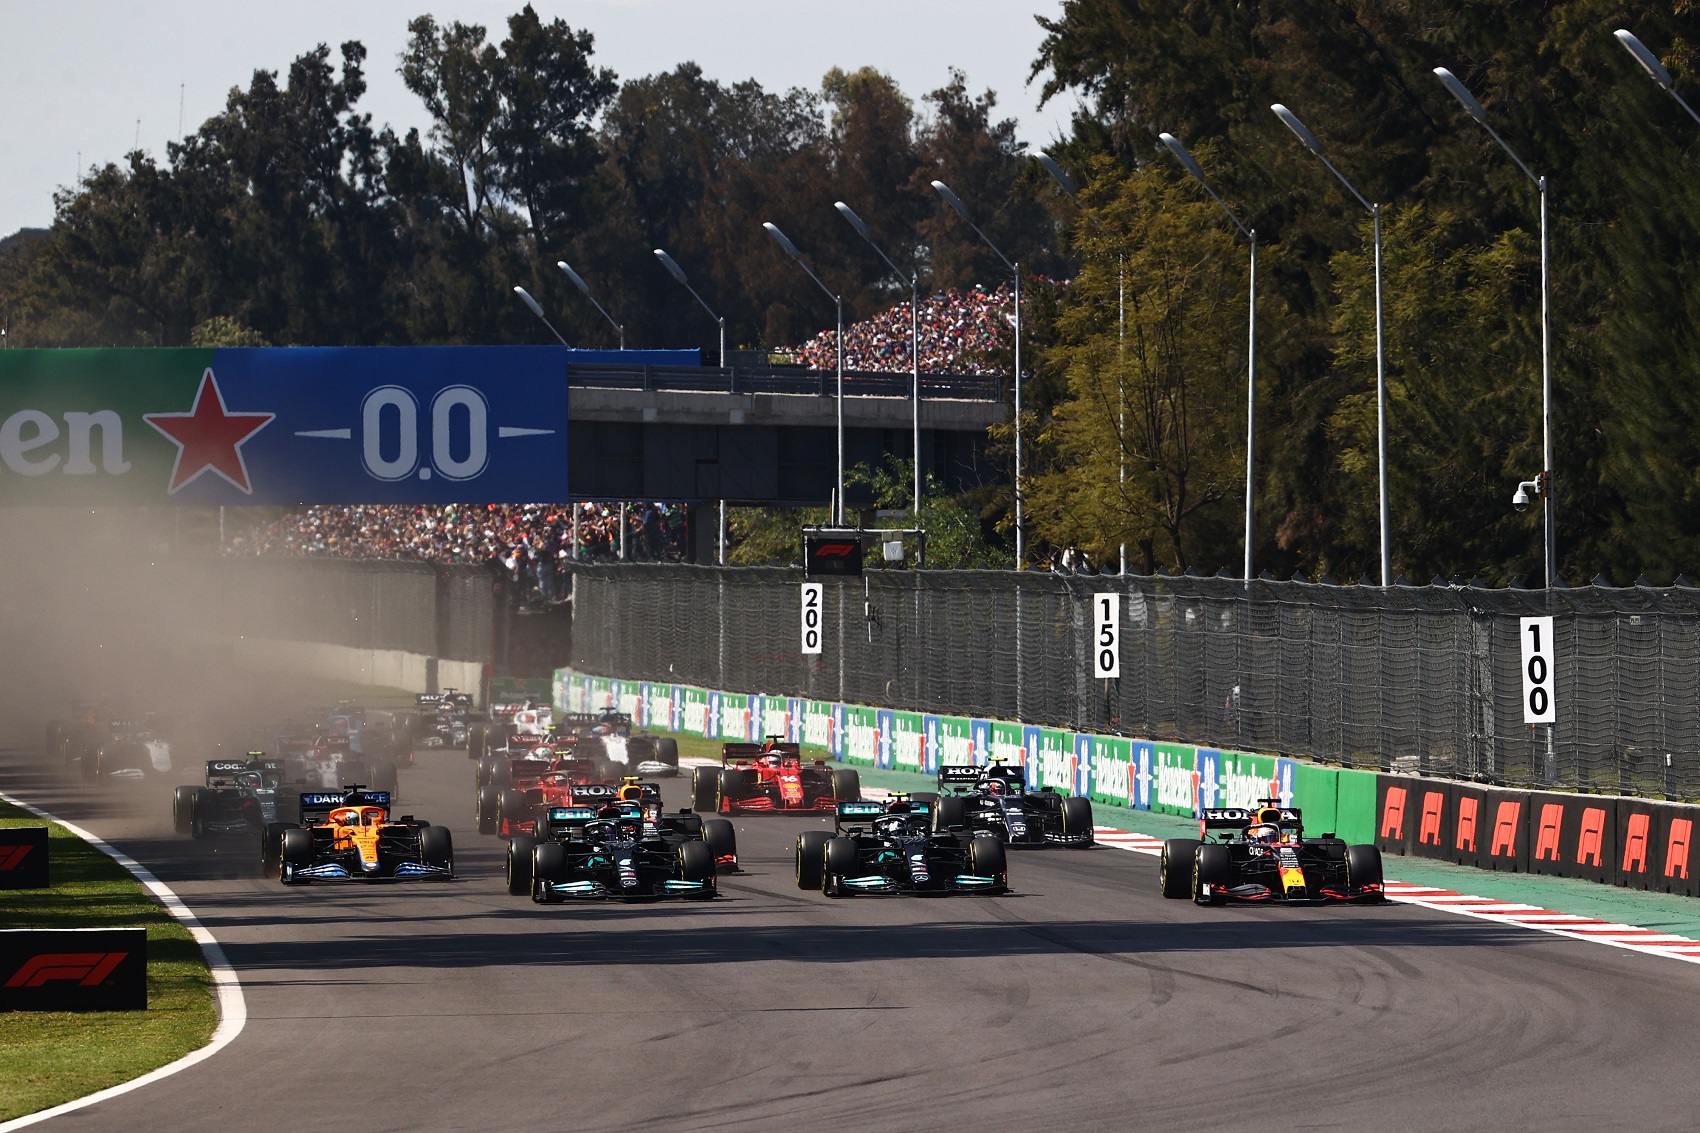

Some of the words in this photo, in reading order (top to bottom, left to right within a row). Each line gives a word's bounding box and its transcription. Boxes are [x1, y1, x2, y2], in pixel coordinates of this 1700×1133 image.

[360, 384, 490, 482] 0.0
[805, 588, 818, 648] 200
[1100, 599, 1115, 672] 150
[1528, 624, 1549, 716] 100
